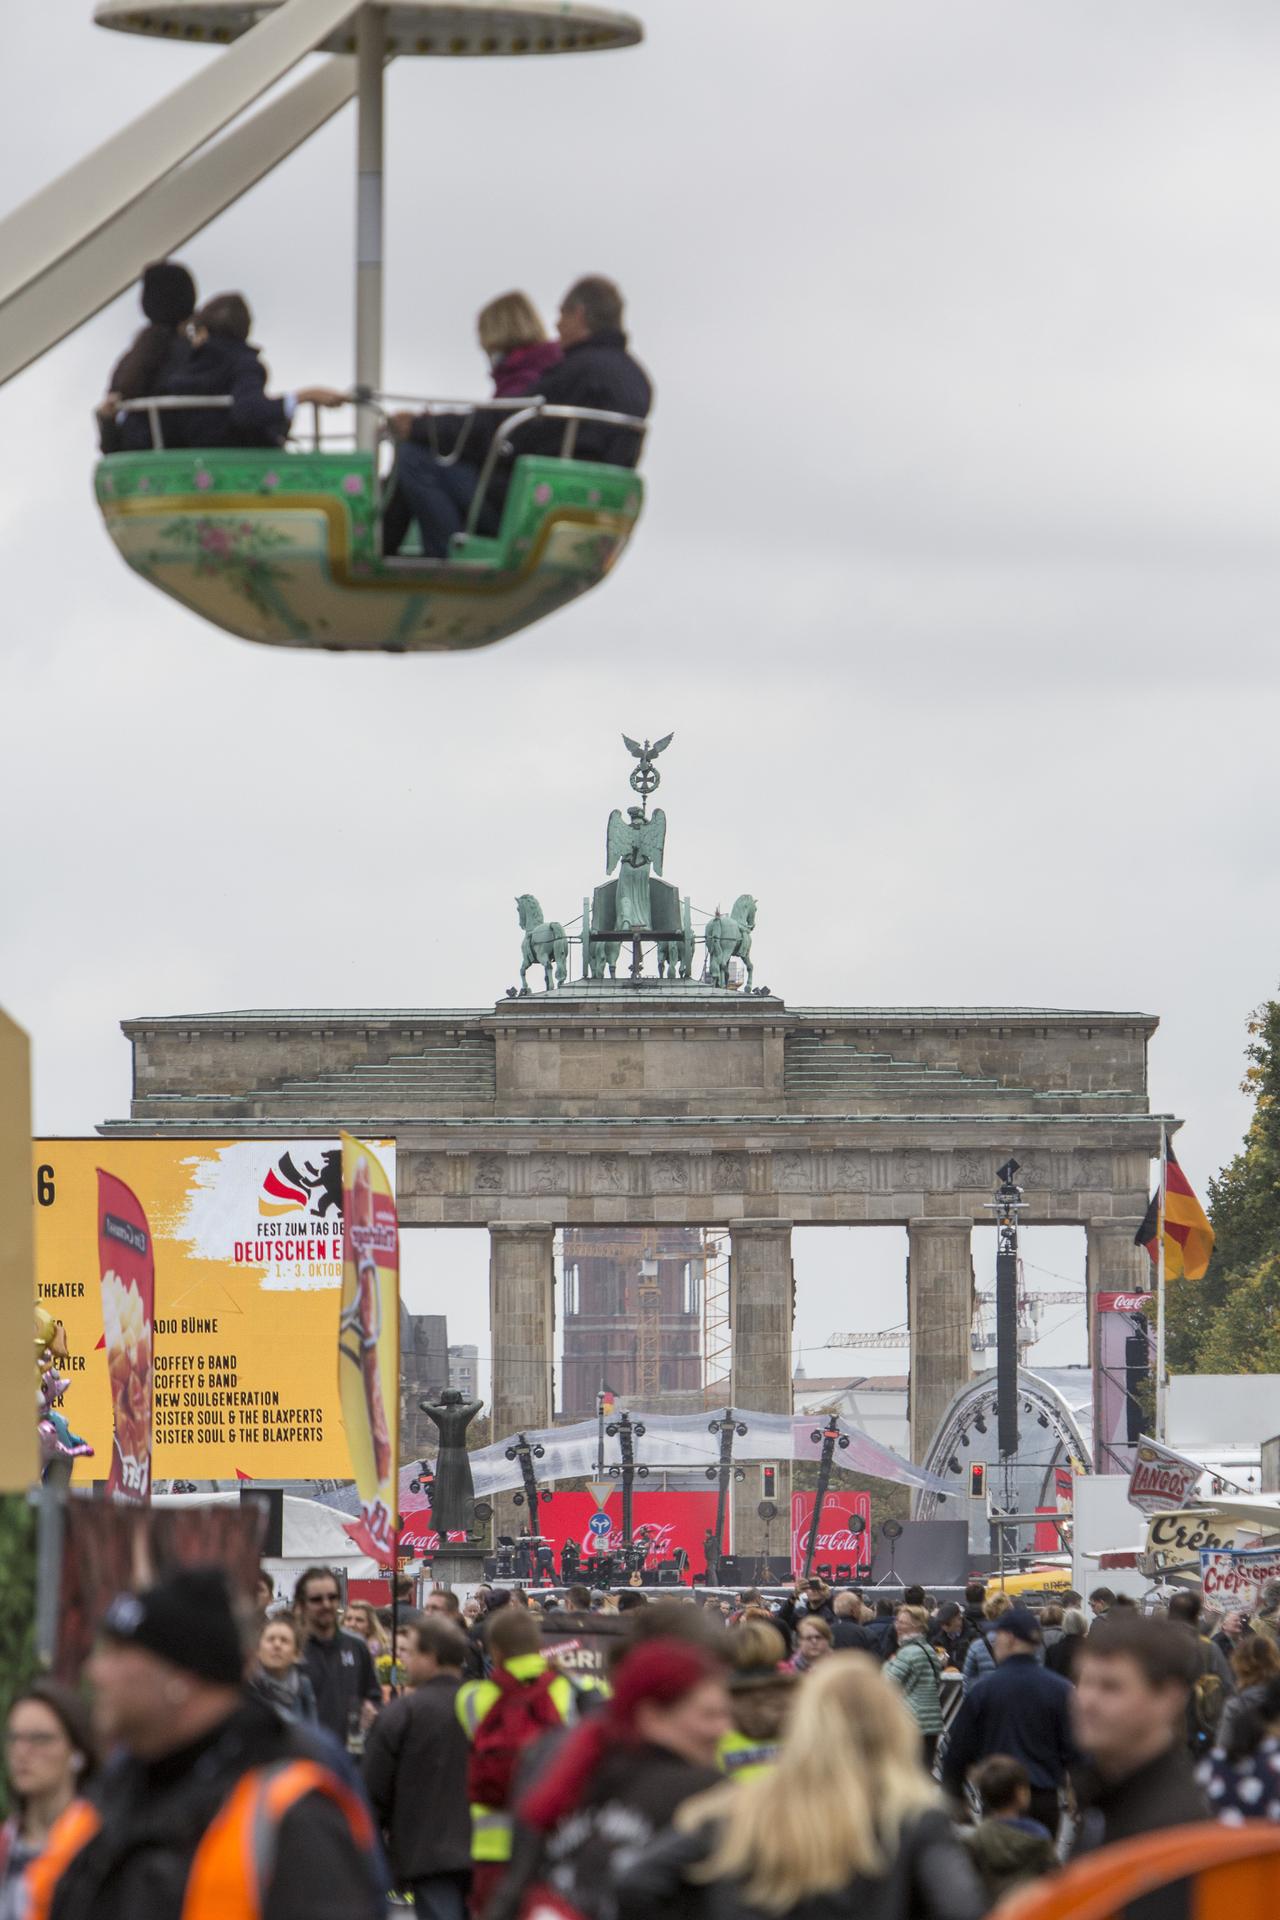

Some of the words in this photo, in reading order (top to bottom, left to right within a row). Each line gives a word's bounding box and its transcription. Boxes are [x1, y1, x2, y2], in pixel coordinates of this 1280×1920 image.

[257, 1223, 281, 1236] FEST
[285, 1223, 307, 1236] ZUM
[311, 1222, 329, 1236] TAG
[332, 1222, 344, 1236] DE
[234, 1240, 327, 1262] DEUTSCHEN
[333, 1239, 341, 1260] E
[308, 1263, 342, 1277] OKTOB
[38, 1283, 85, 1298] THEATER
[153, 1320, 178, 1334] ADIO
[181, 1317, 218, 1333] BÜHNE
[53, 1356, 86, 1371] EATER
[154, 1356, 195, 1371] COFFEY
[198, 1355, 205, 1370] &
[208, 1355, 237, 1369] BAND
[154, 1374, 195, 1389] COFFEY
[198, 1374, 205, 1388] &
[208, 1373, 238, 1388] BAND
[155, 1393, 181, 1408] NEW
[183, 1391, 279, 1407] SOULGENERATION
[155, 1411, 194, 1425] SISTER
[198, 1410, 226, 1425] SOUL
[228, 1410, 236, 1424] &
[239, 1409, 259, 1424] THE
[262, 1408, 323, 1423] BLAXPERTS
[155, 1429, 194, 1444] SISTER
[198, 1429, 226, 1443] SOUL
[228, 1428, 236, 1443] &
[239, 1428, 259, 1442] THE
[262, 1427, 323, 1442] BLAXPERTS
[800, 1529, 858, 1551] Cca-Cola
[560, 1649, 602, 1669] GRI
